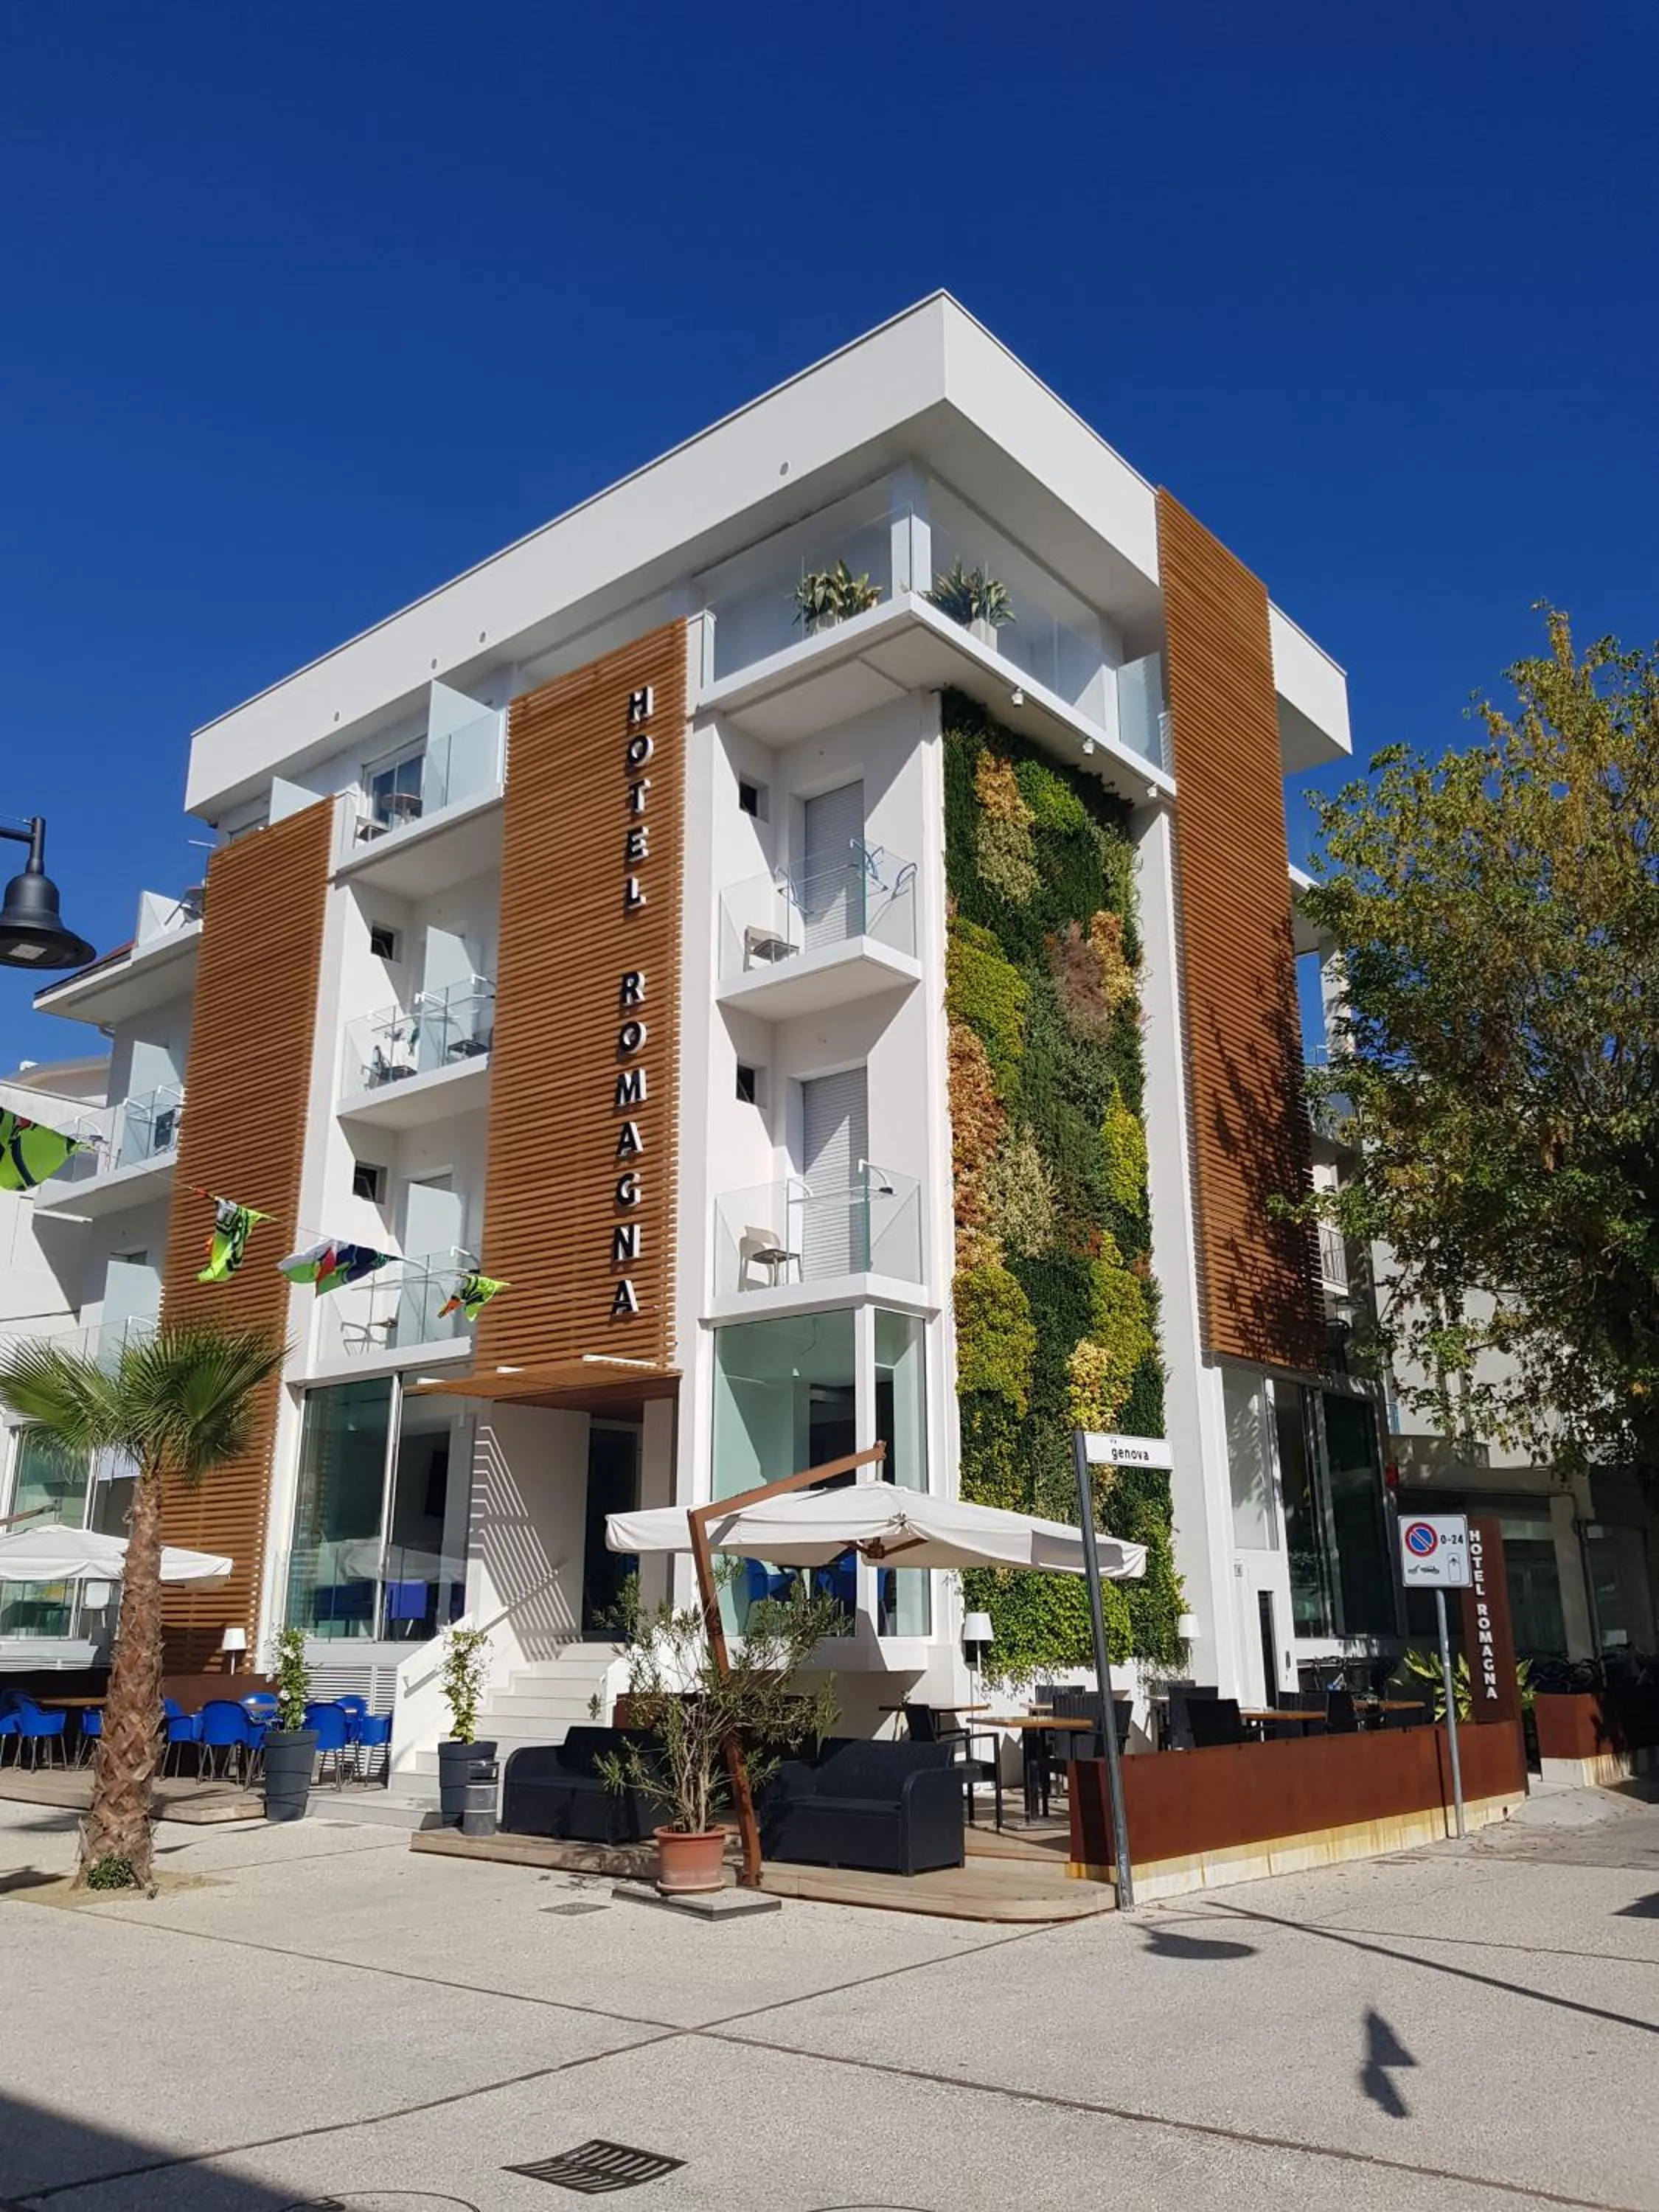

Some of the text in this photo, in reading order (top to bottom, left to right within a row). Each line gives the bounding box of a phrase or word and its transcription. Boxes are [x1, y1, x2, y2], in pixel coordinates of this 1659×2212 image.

[611, 685, 654, 1316] HOTEL ROMAGNA
[1111, 1447, 1149, 1461] genova
[1440, 1534, 1464, 1545] 0-24
[1469, 1530, 1498, 1700] HOTEL ROMAGNA
